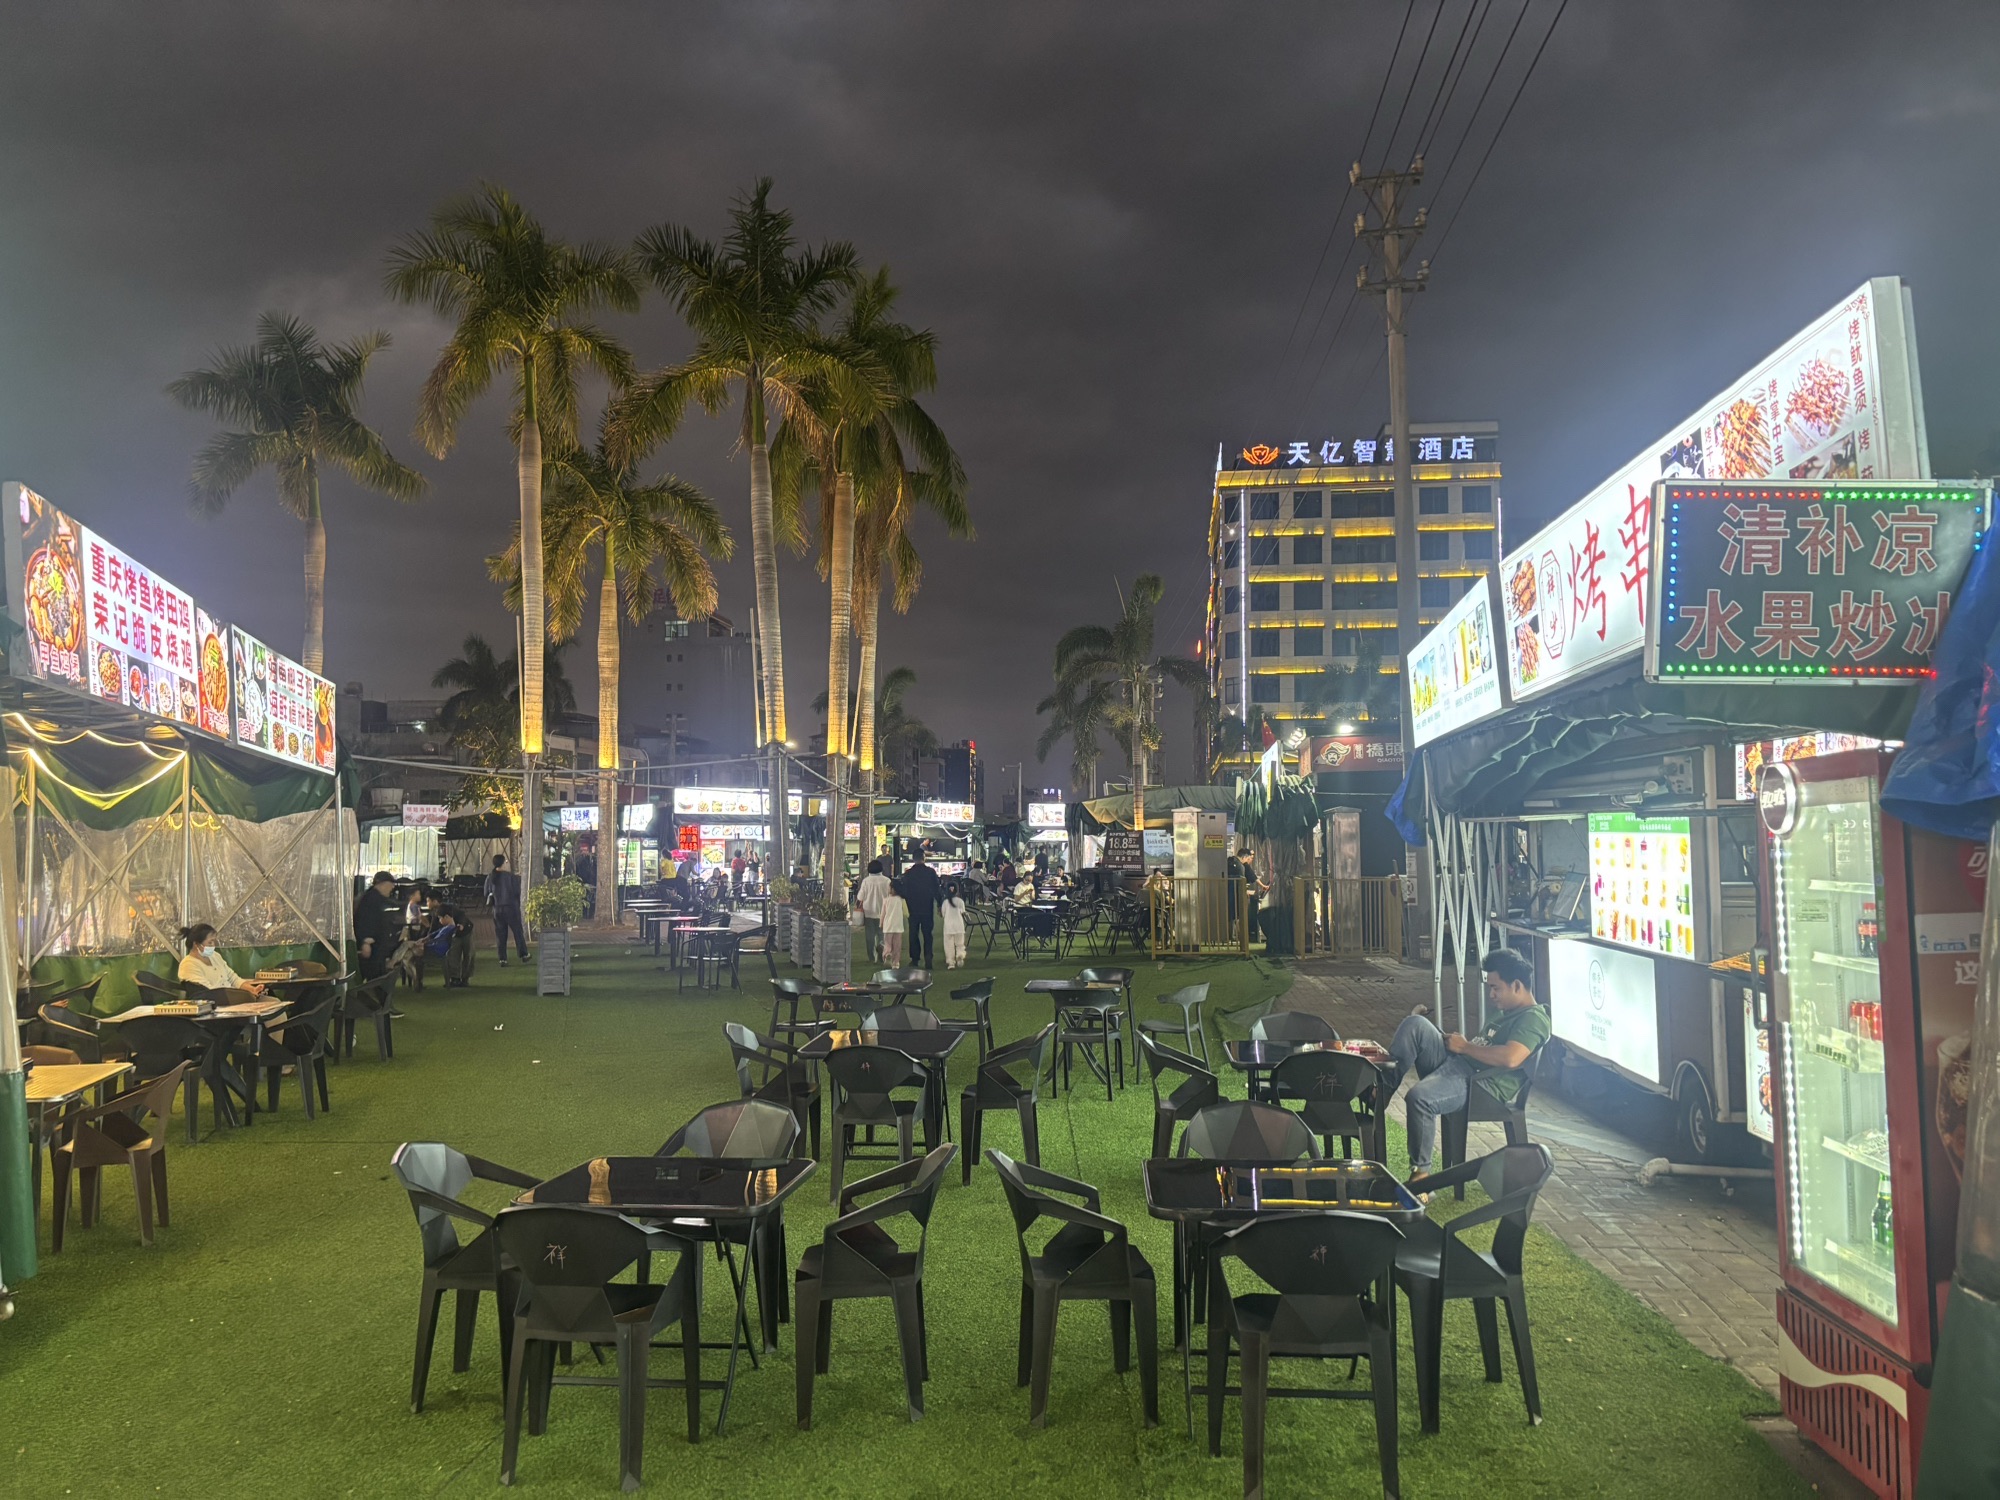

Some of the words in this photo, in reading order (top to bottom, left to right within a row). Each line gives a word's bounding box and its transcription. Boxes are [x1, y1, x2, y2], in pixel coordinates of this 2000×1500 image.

[1717, 504, 1937, 575] 清补凉
[90, 541, 190, 634] 重庆烤鱼烤田鸡
[93, 591, 193, 674] 荣记脆皮烧鸡
